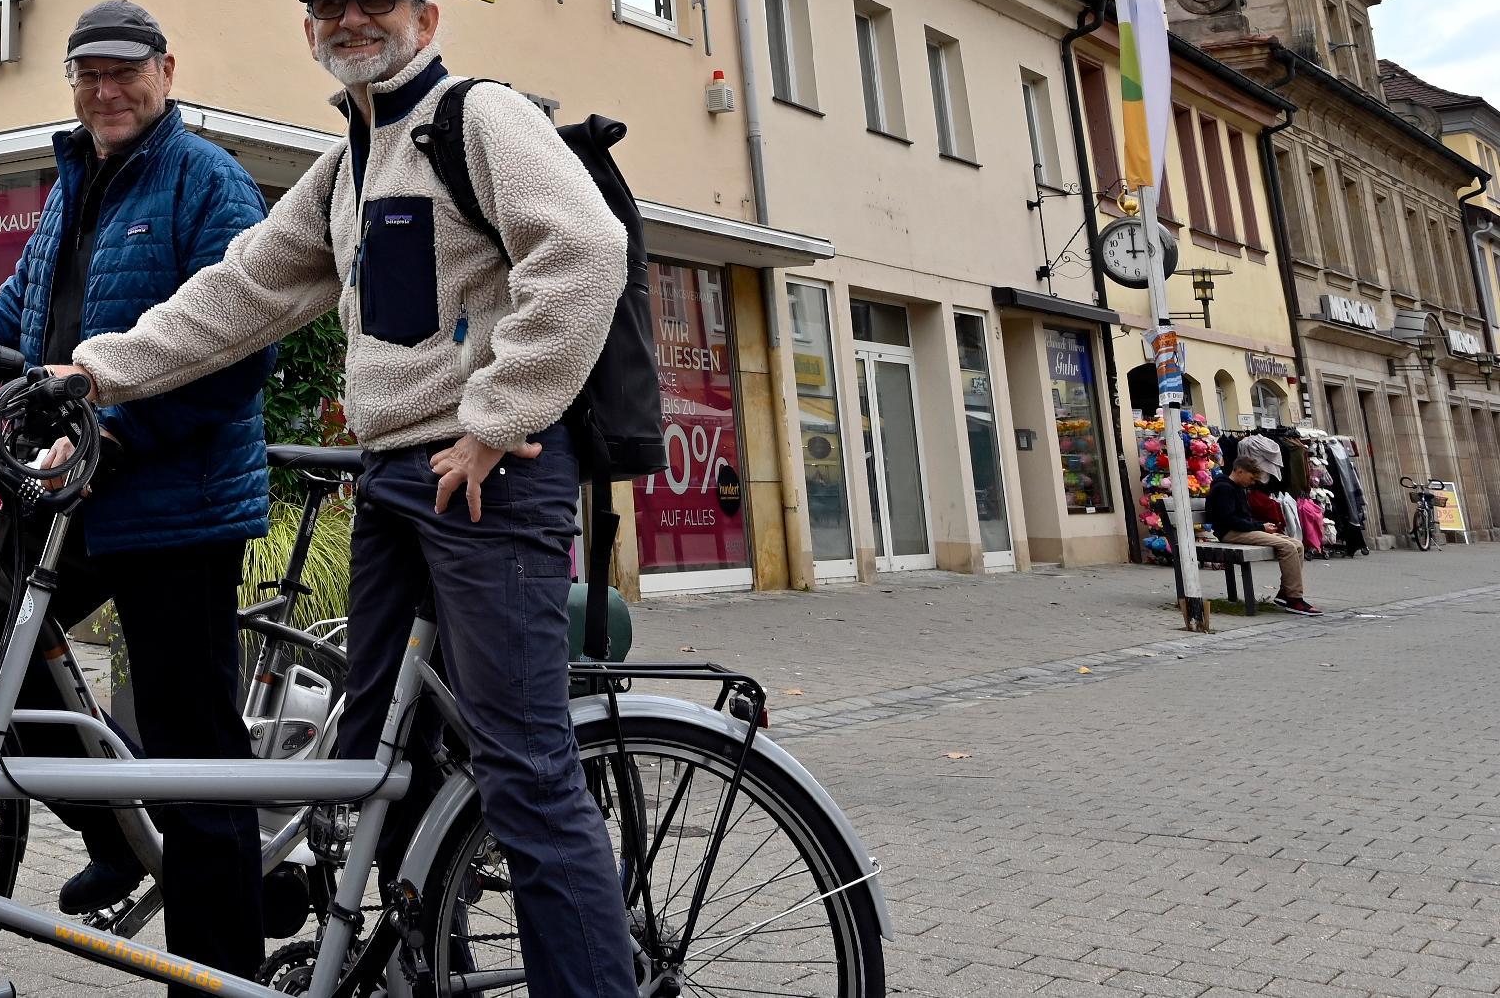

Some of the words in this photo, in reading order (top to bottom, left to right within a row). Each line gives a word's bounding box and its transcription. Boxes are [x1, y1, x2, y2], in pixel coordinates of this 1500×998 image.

[1116, 232, 1124, 240] 11
[1109, 240, 1119, 248] 10
[1108, 249, 1115, 258] 9
[1113, 259, 1120, 267] 8
[1122, 265, 1127, 274] 7
[1134, 268, 1141, 277] 6
[658, 318, 690, 344] WIR
[654, 343, 722, 372] HLIESSEN
[663, 397, 680, 415] BIS
[682, 399, 697, 416] ZU
[660, 509, 682, 527] AUF
[684, 508, 716, 527] ALLES
[55, 922, 223, 991] www.freilauf.de
